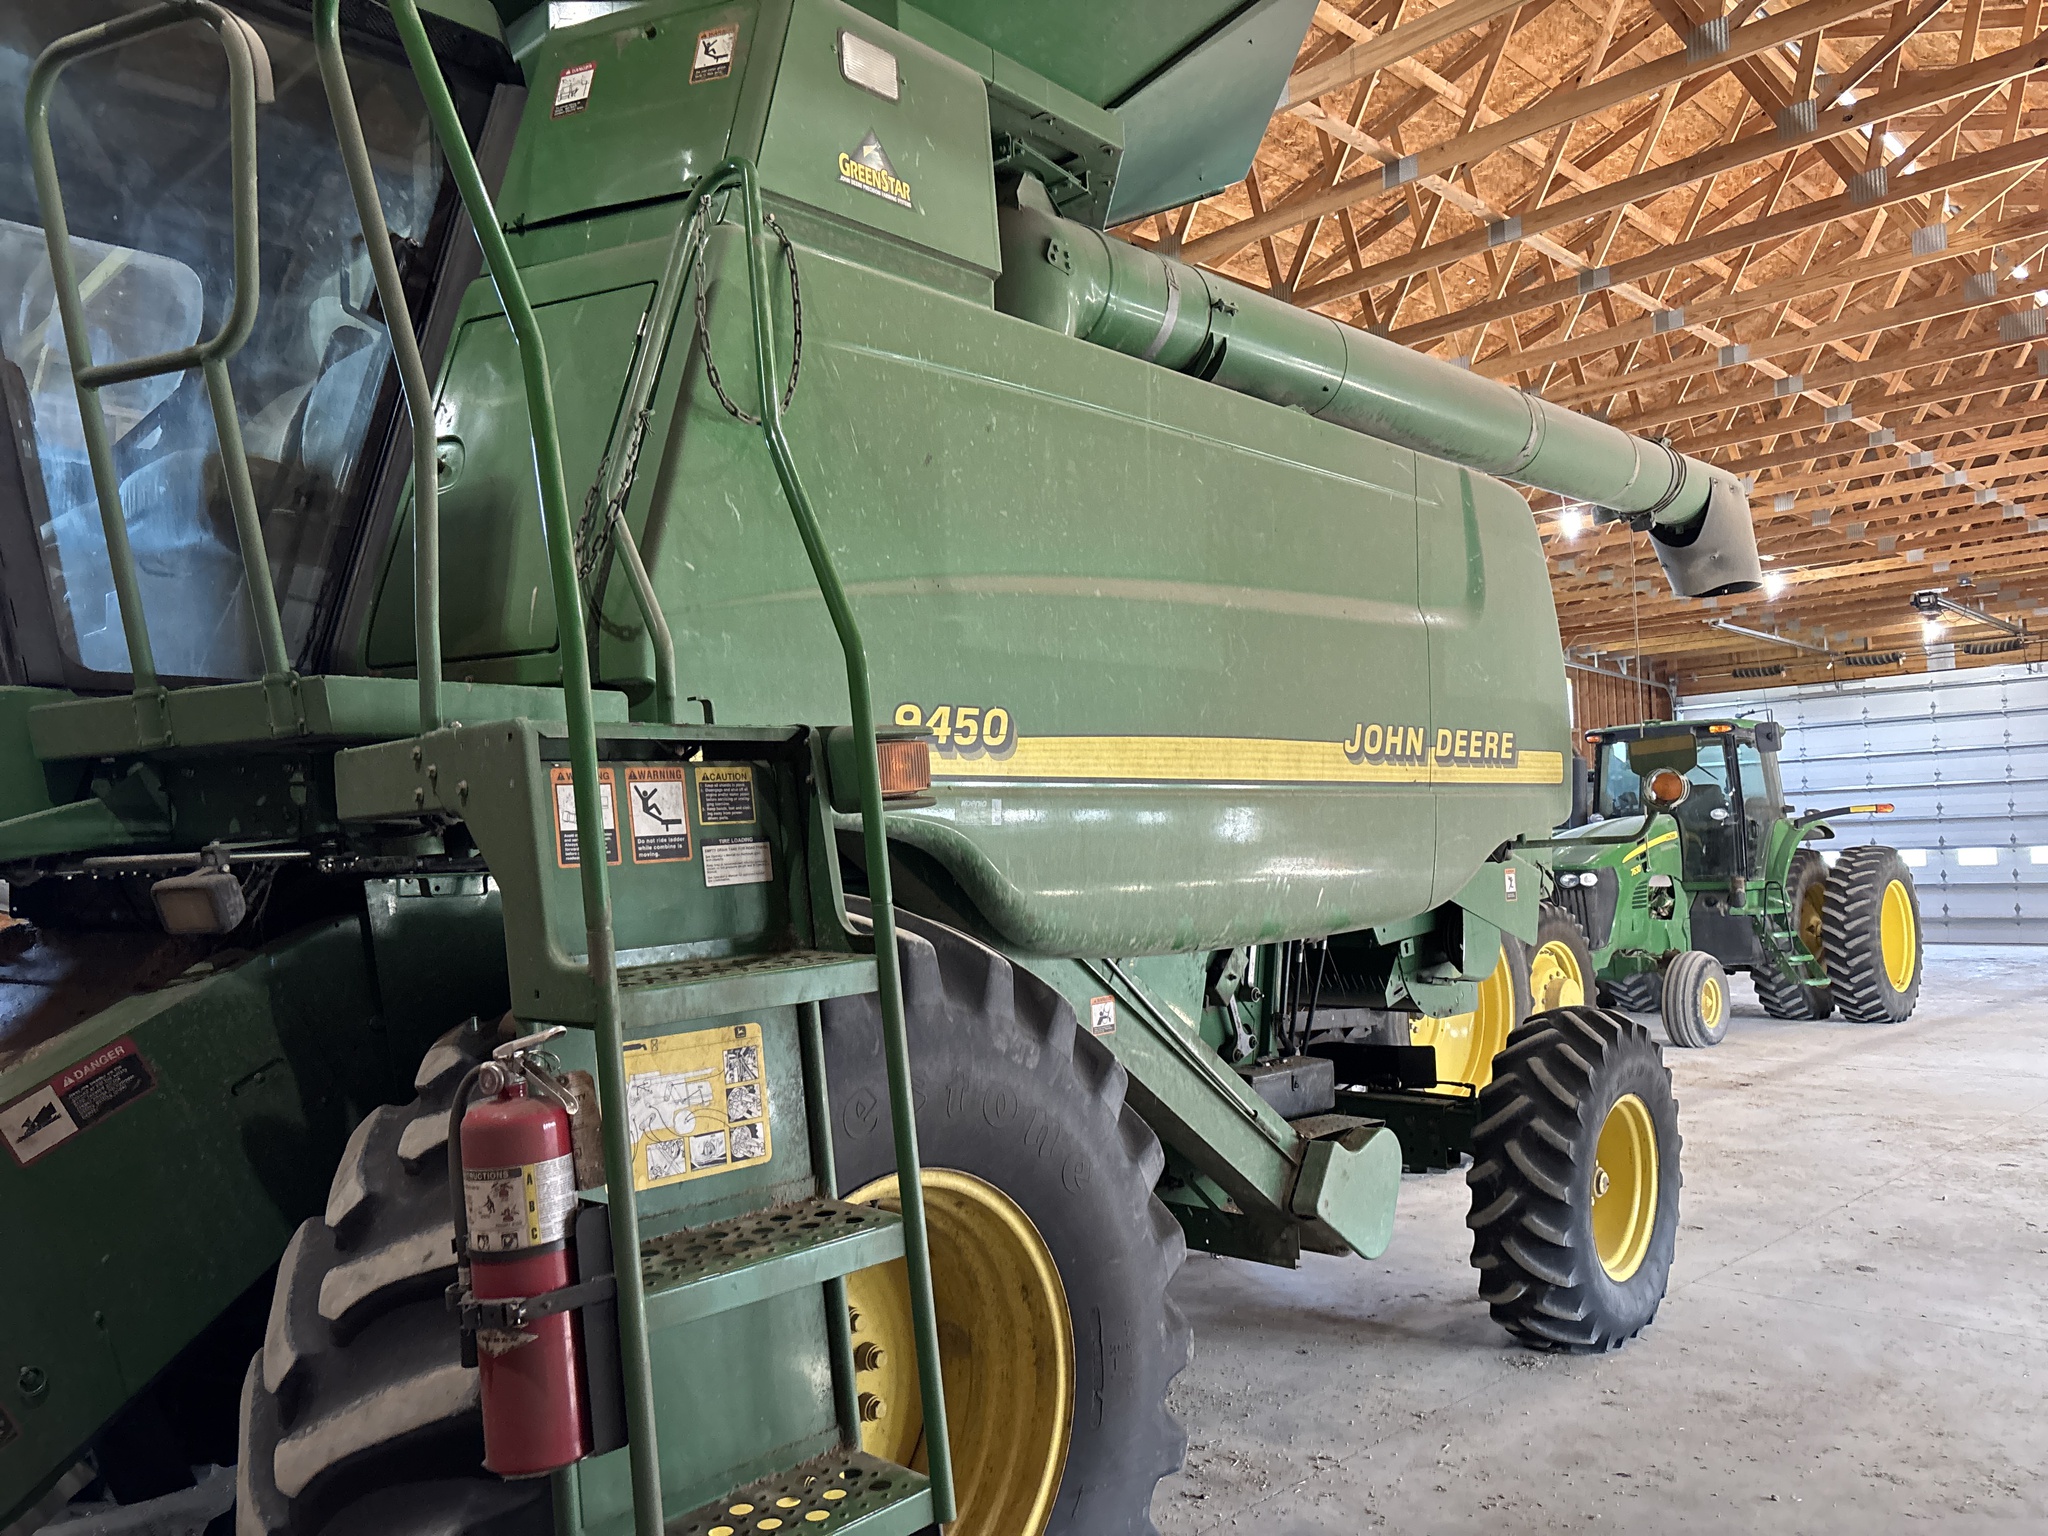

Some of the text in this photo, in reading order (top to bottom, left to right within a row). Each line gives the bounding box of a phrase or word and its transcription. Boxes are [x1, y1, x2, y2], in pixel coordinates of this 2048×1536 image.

[895, 704, 1010, 747] 9450
[1344, 723, 1515, 760] JOHN DEERE
[637, 769, 682, 780] WARNING
[710, 772, 747, 780] CAUTION
[73, 1045, 125, 1080] DANGER
[527, 1174, 538, 1239] A B C
